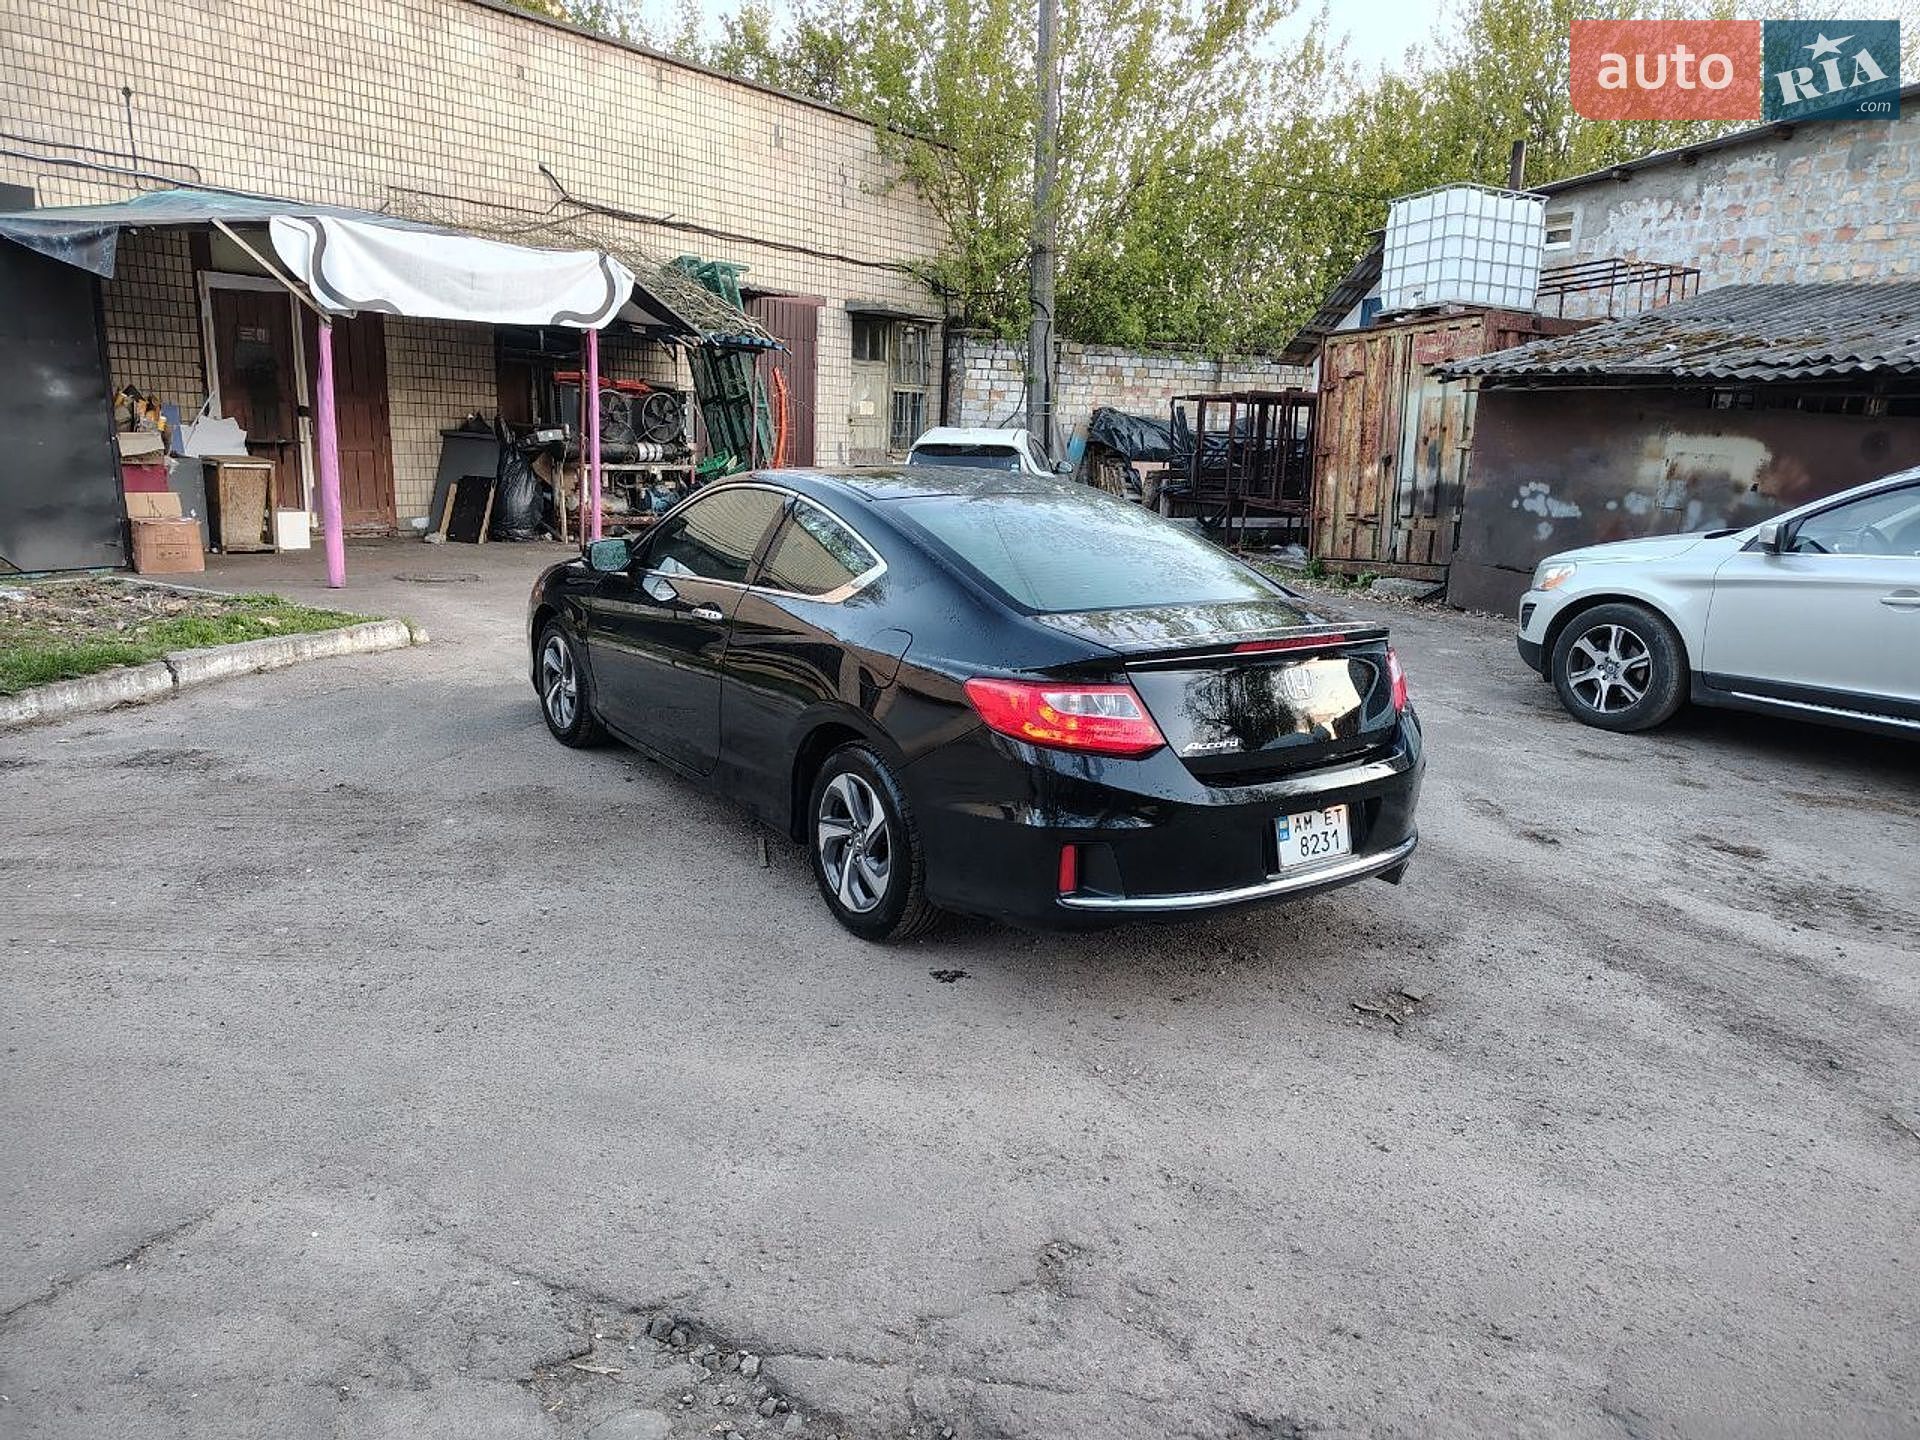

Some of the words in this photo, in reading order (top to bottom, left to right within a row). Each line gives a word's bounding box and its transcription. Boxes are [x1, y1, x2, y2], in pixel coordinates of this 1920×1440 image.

[1182, 738, 1239, 752] Accord
[1294, 814, 1313, 834] AM
[1324, 808, 1342, 826] ET
[1300, 828, 1340, 857] 8231
